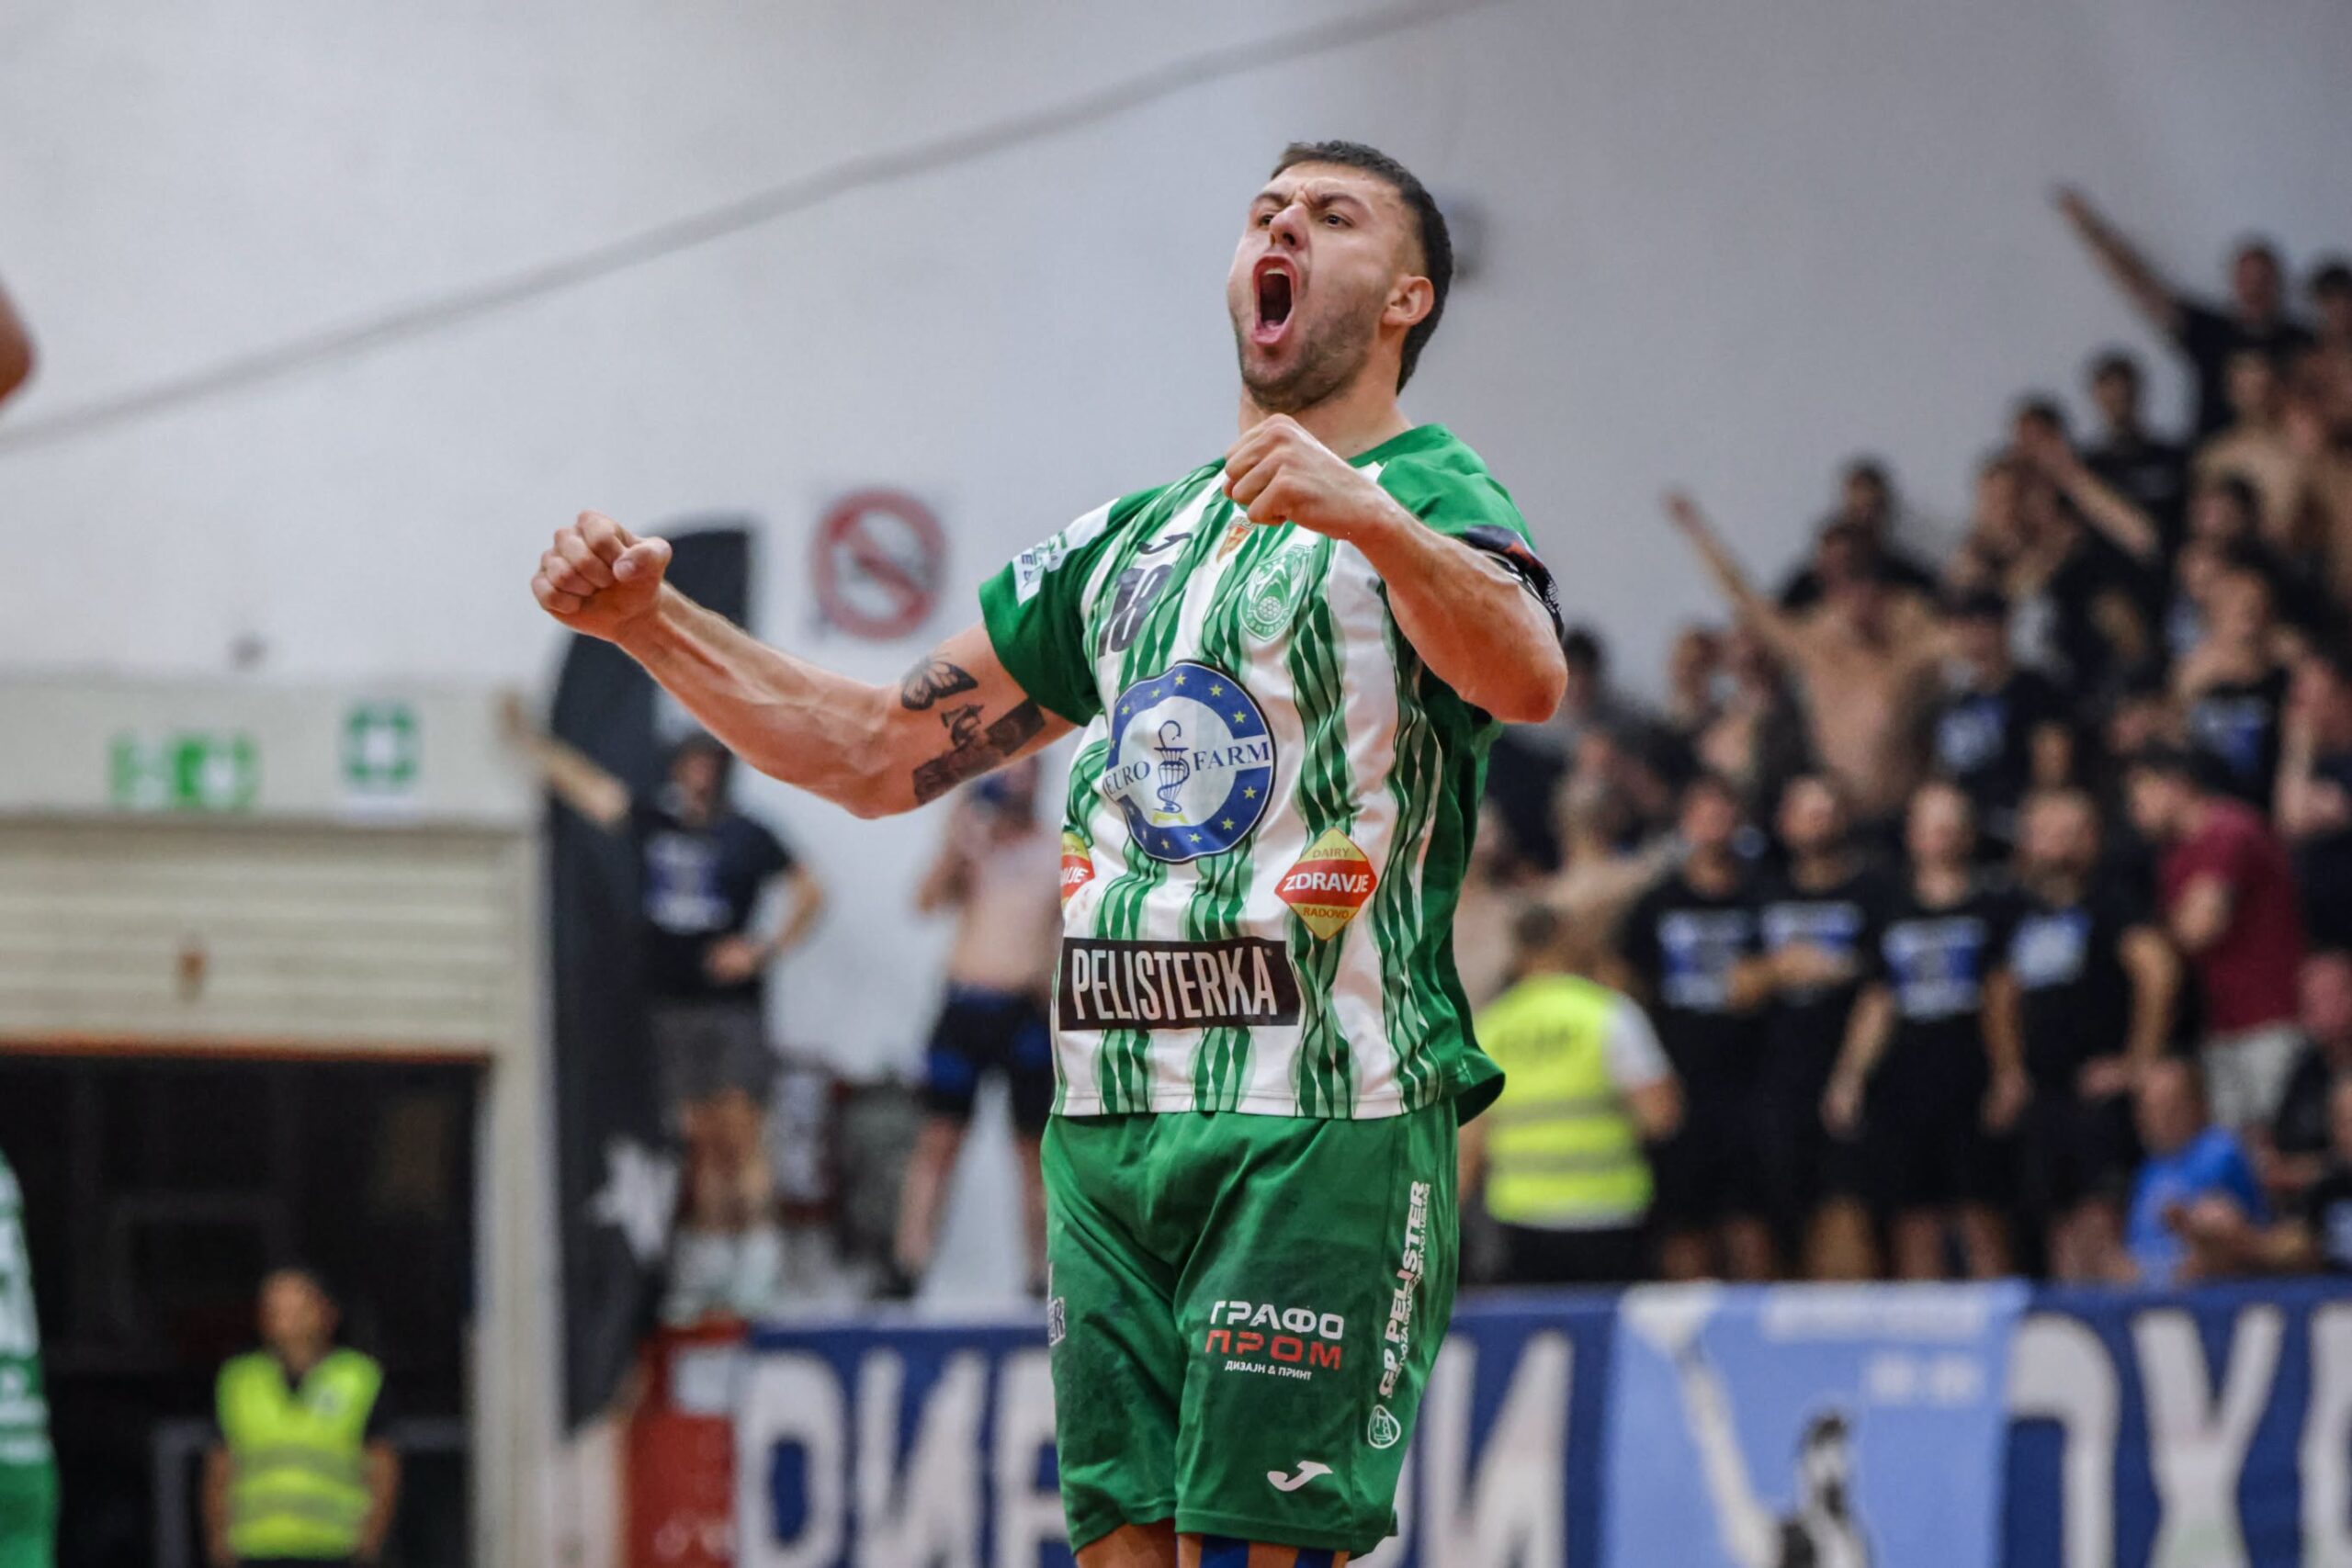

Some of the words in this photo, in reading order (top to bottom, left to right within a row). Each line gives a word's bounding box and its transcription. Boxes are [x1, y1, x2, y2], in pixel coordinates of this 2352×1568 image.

[1103, 760, 1151, 795] EURO
[1193, 740, 1271, 772] FARM
[1312, 847, 1350, 859] DAIRY
[1283, 872, 1370, 894] ZDRAVJE
[1303, 907, 1349, 919] RADOVO
[1071, 945, 1278, 1021] PELISTERKA
[1385, 1180, 1424, 1344] PELISTER
[1209, 1300, 1345, 1340] ГРАФО
[1204, 1329, 1342, 1371] ПРОМ
[1224, 1359, 1266, 1374] ДИЗАЈН
[1267, 1365, 1276, 1375] &
[1278, 1367, 1312, 1381] ПРИНТ
